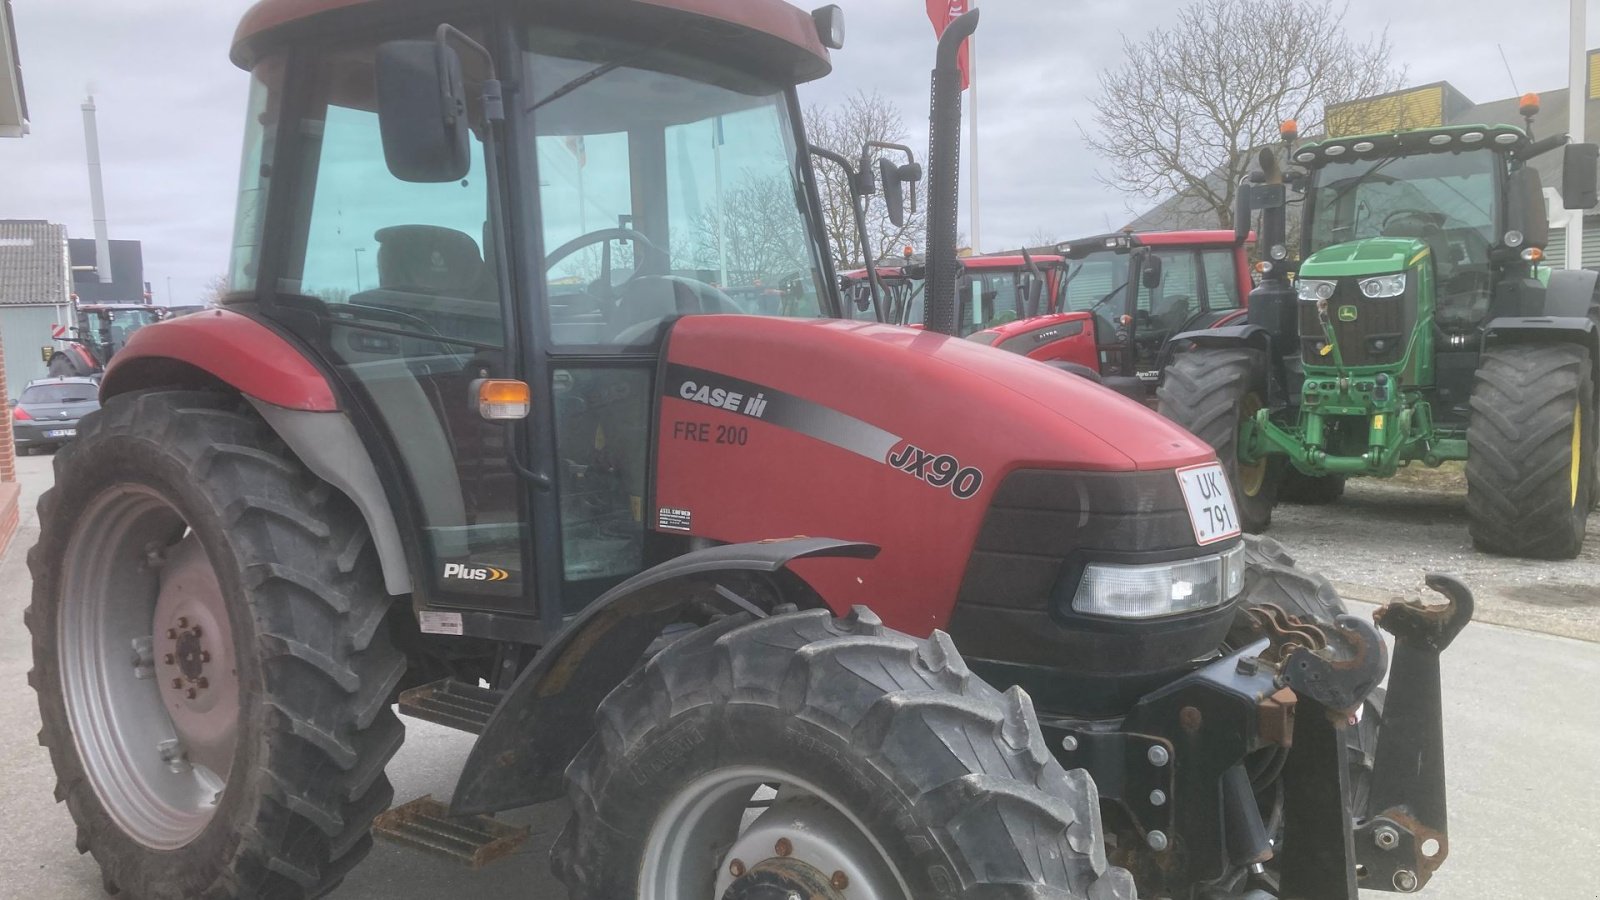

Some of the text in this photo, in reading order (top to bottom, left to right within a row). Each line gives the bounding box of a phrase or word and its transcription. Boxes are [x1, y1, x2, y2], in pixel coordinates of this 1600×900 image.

[680, 381, 743, 412] CASE
[673, 420, 748, 446] FRE 200
[889, 443, 984, 500] JX90
[1196, 471, 1222, 500] UK
[1202, 503, 1232, 534] 791
[443, 563, 488, 580] Plus
